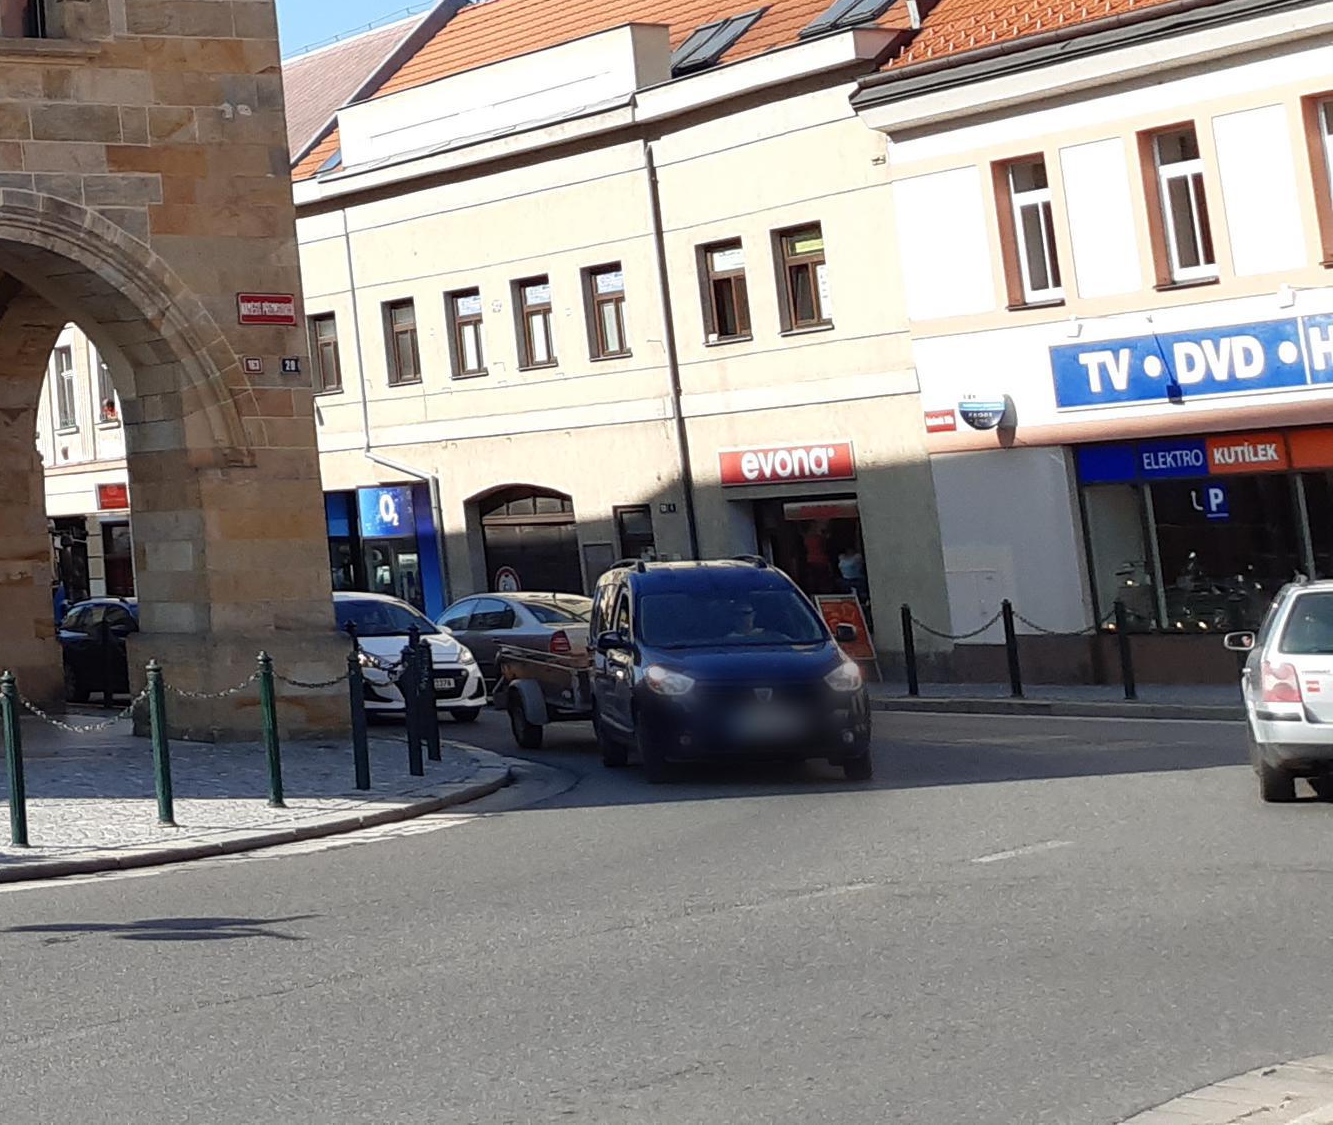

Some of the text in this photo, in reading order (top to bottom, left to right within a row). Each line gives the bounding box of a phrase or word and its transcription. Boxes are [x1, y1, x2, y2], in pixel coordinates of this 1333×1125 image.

[1078, 348, 1131, 394] TV
[1173, 334, 1266, 385] DVD
[741, 447, 832, 480] evona
[1142, 440, 1279, 470] ELEKTRO KUTÍLEK
